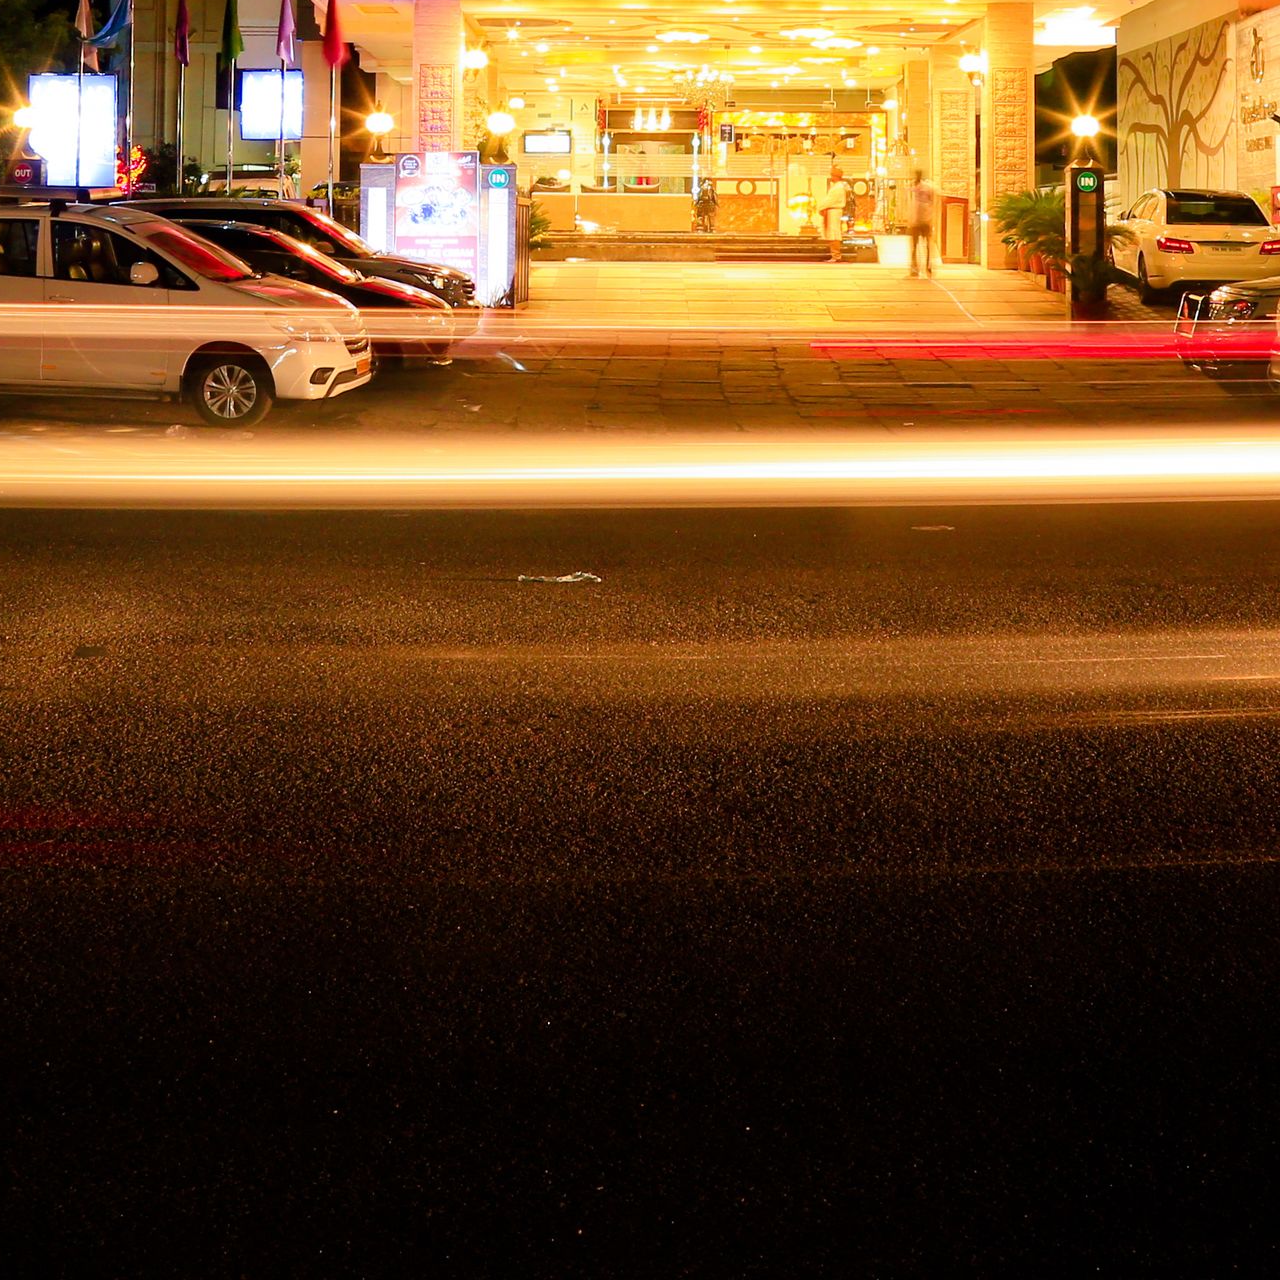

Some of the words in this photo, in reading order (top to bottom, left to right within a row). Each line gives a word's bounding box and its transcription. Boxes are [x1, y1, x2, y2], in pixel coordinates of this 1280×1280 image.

[15, 169, 31, 177] OUT
[491, 173, 506, 184] IN
[1080, 177, 1094, 187] IN
